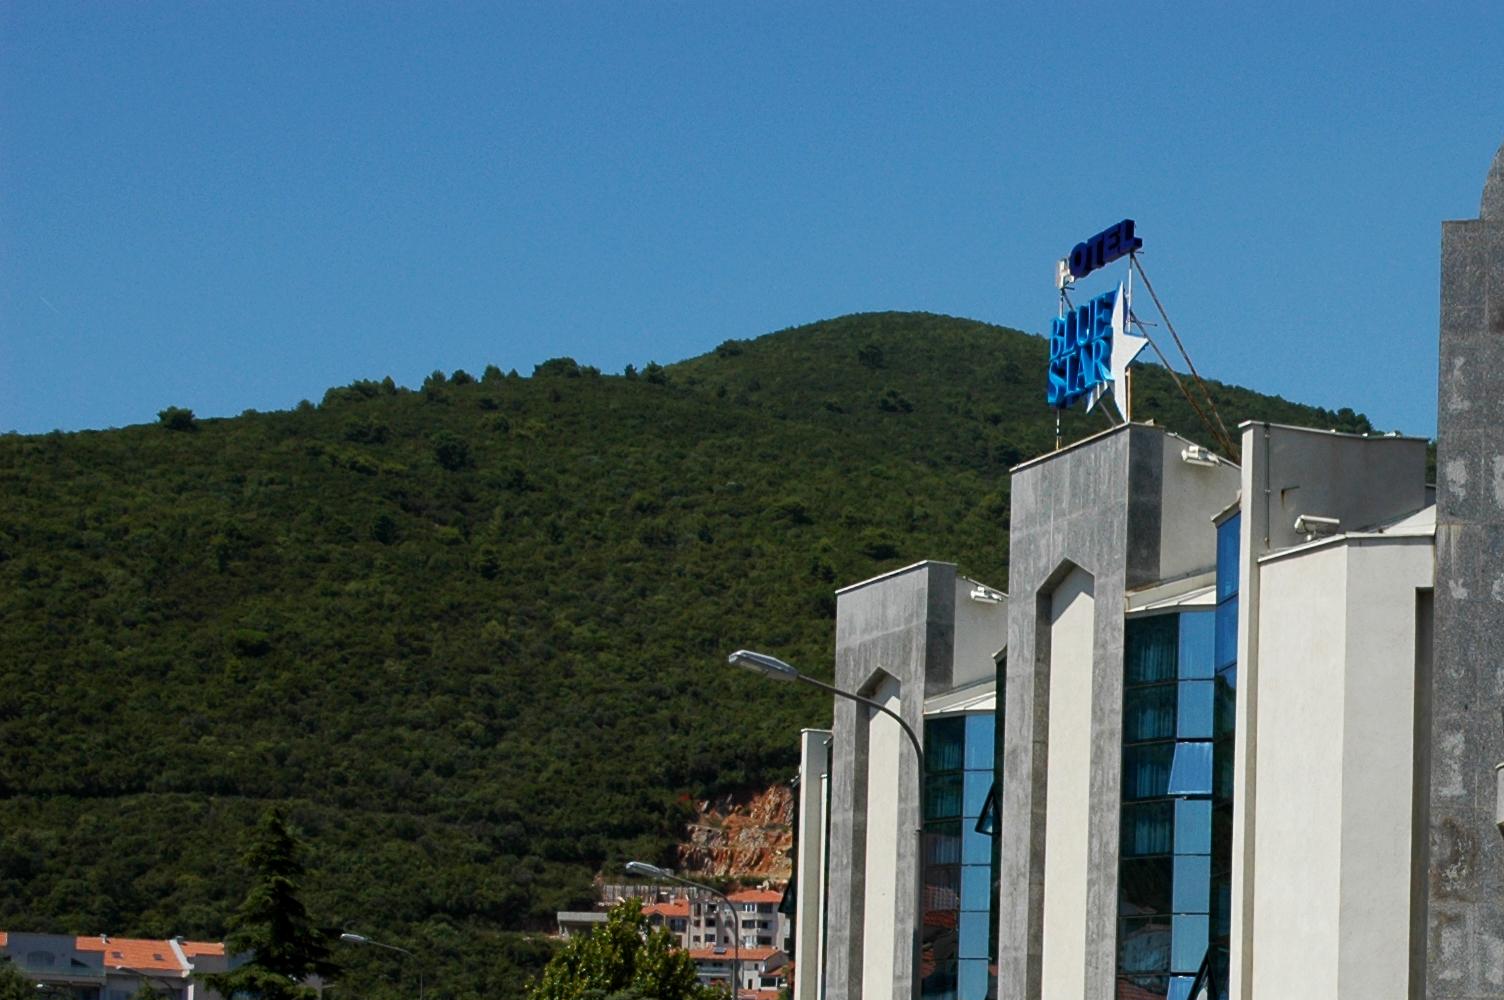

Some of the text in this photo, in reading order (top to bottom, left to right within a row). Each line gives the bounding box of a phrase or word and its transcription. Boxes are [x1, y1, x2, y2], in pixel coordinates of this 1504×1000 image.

[1056, 218, 1143, 290] HOTEL
[1049, 289, 1117, 361] BLUE
[1047, 337, 1115, 407] STAR
